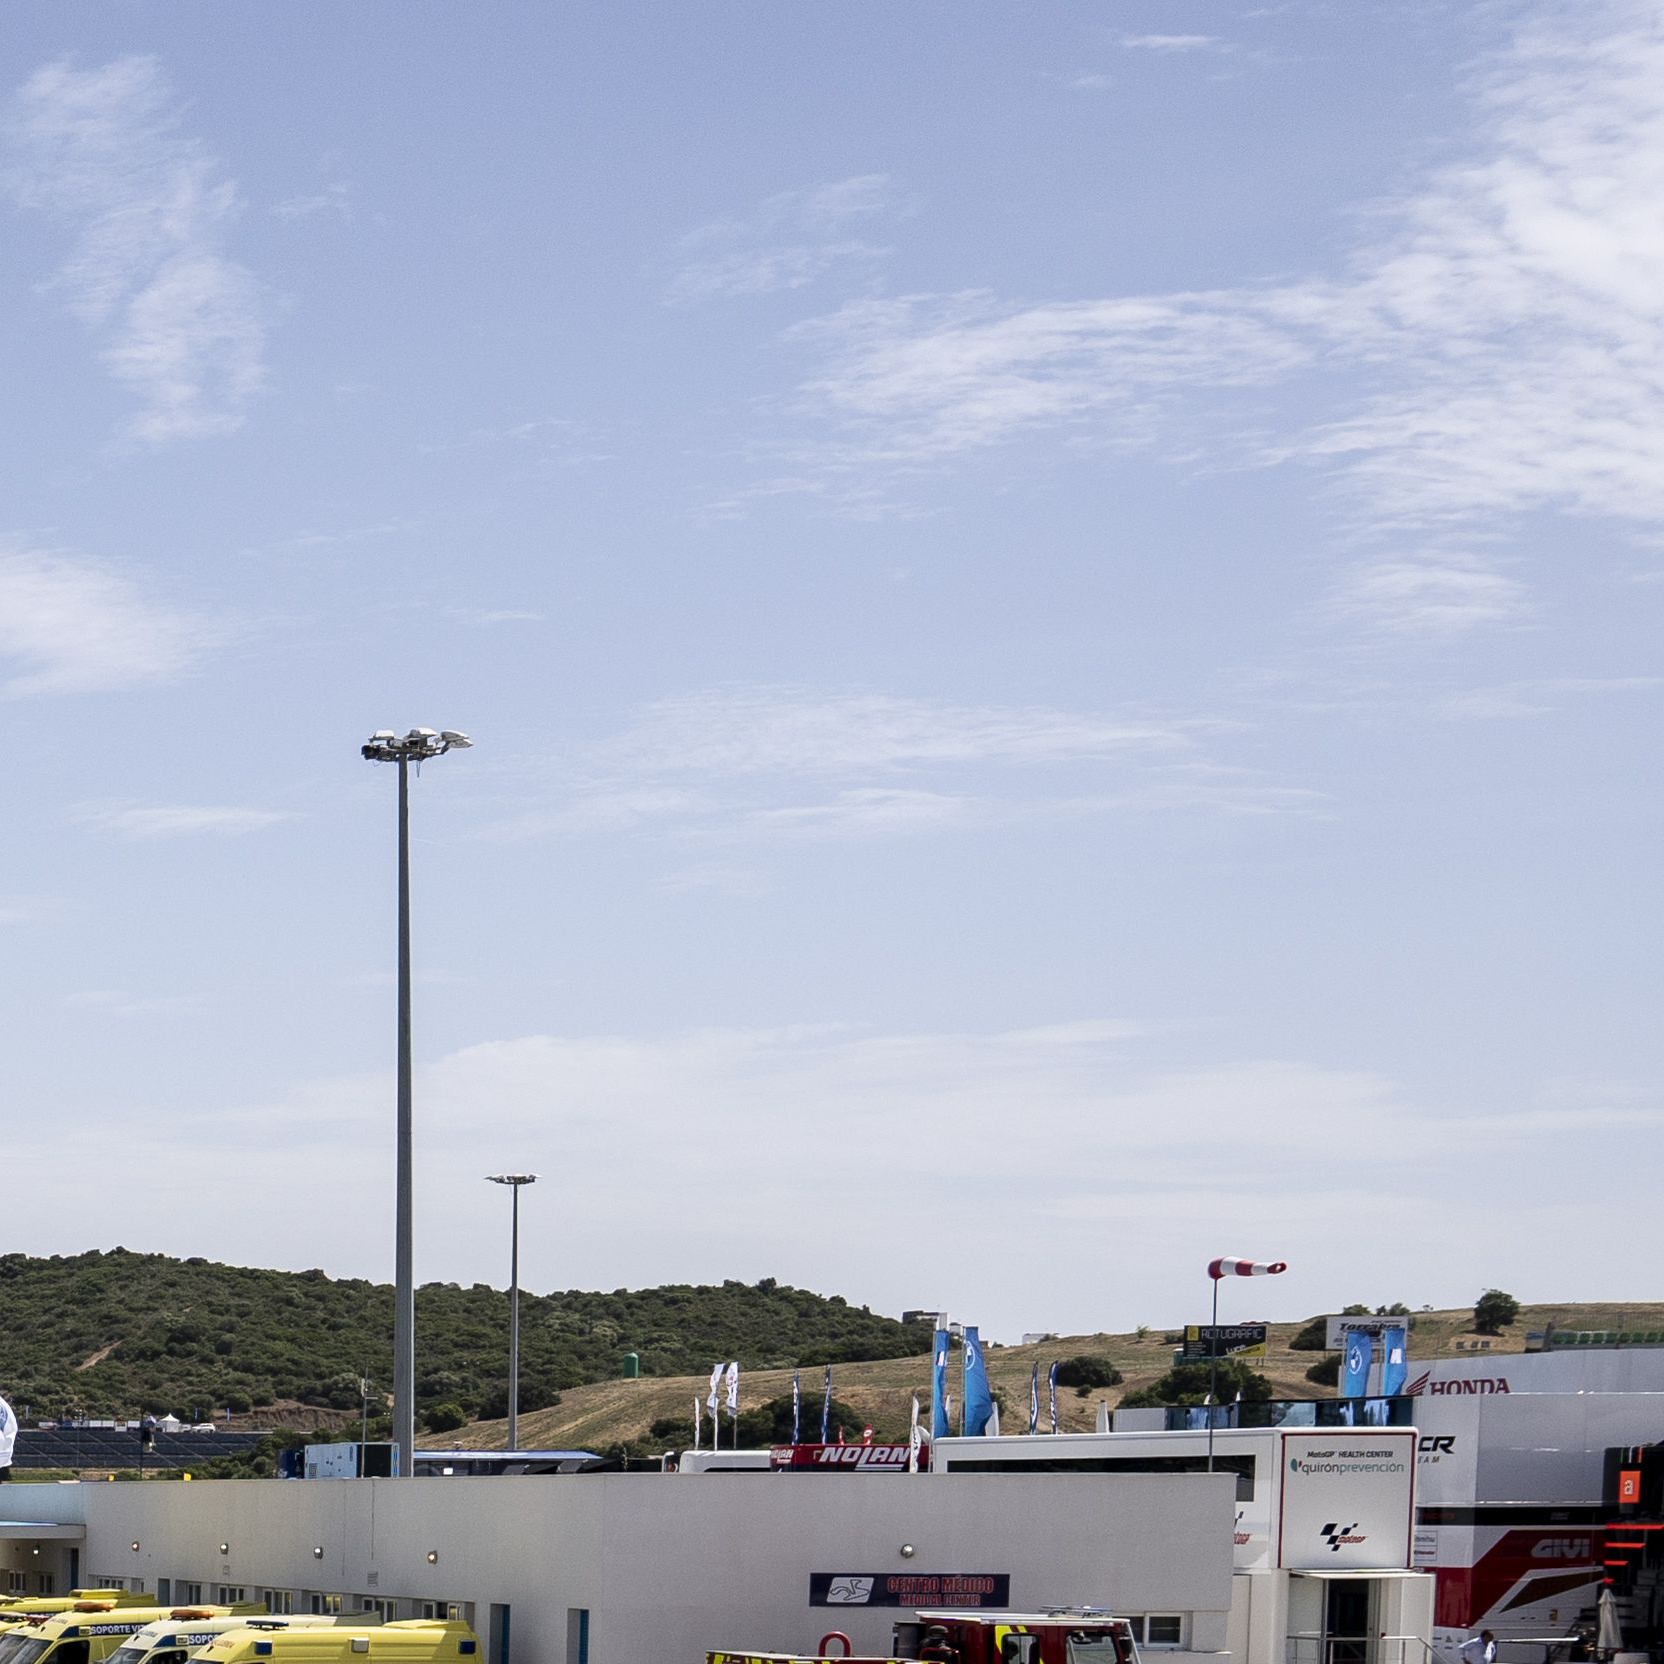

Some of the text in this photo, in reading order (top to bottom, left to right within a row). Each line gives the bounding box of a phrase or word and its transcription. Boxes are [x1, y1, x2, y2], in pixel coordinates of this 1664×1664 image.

[1429, 1378, 1511, 1396] HONDA
[819, 1447, 911, 1471] NOLAN
[1338, 1450, 1365, 1458] HEALTH
[1366, 1450, 1394, 1458] CENTER
[1301, 1460, 1405, 1476] quirónprevención
[1530, 1538, 1591, 1558] GIVI
[887, 1574, 994, 1593] CENTRO MÉDICO
[899, 1594, 981, 1606] MEDICAL CENTER
[91, 1625, 132, 1635] SOPORTE
